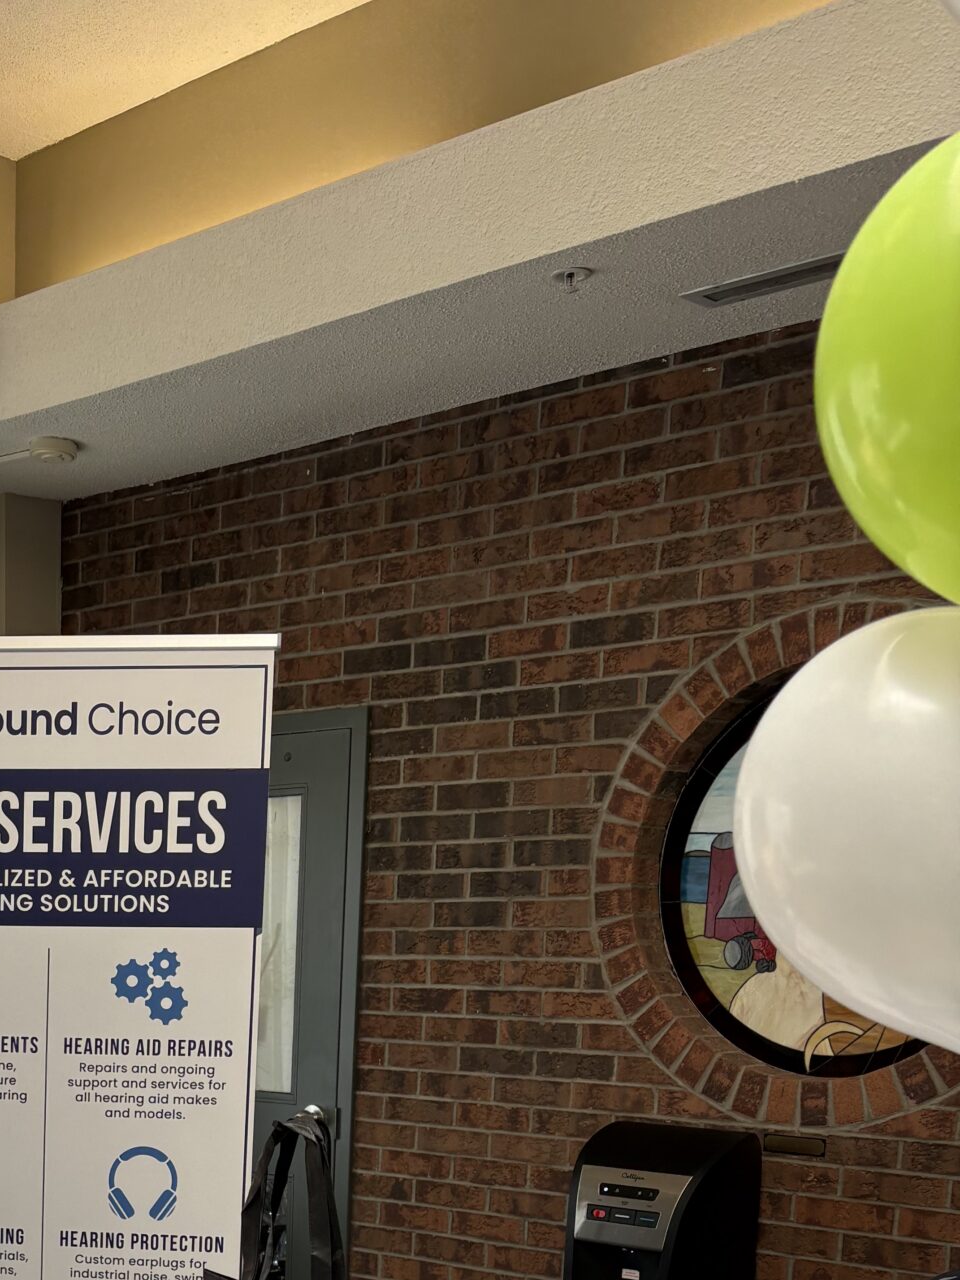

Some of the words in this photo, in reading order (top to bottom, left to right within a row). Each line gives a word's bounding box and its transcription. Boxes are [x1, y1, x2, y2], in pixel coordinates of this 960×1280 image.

[88, 700, 220, 735] Choice
[59, 869, 76, 887] &
[83, 870, 232, 888] AFFORDABLE
[40, 894, 169, 913] SOLUTIONS
[64, 1037, 129, 1055] HEARING
[136, 1039, 161, 1056] AID
[167, 1039, 233, 1057] REPAIRS
[79, 1062, 128, 1076] Repairs
[131, 1063, 157, 1074] and
[160, 1066, 215, 1078] ongoing
[68, 1078, 118, 1091] support
[121, 1078, 147, 1089] and
[151, 1081, 204, 1090] services
[208, 1079, 226, 1090] for
[75, 1092, 90, 1102] all
[94, 1092, 144, 1107] hearing
[148, 1093, 169, 1104] aid
[173, 1094, 217, 1105] makes
[105, 1108, 130, 1118] and
[134, 1109, 185, 1120] models.
[60, 1230, 124, 1249] HEARING
[131, 1233, 224, 1253] PROTECTION
[75, 1254, 125, 1266] Custom
[128, 1257, 186, 1271] earplugs
[189, 1259, 207, 1269] for
[70, 1267, 130, 1280] industrial
